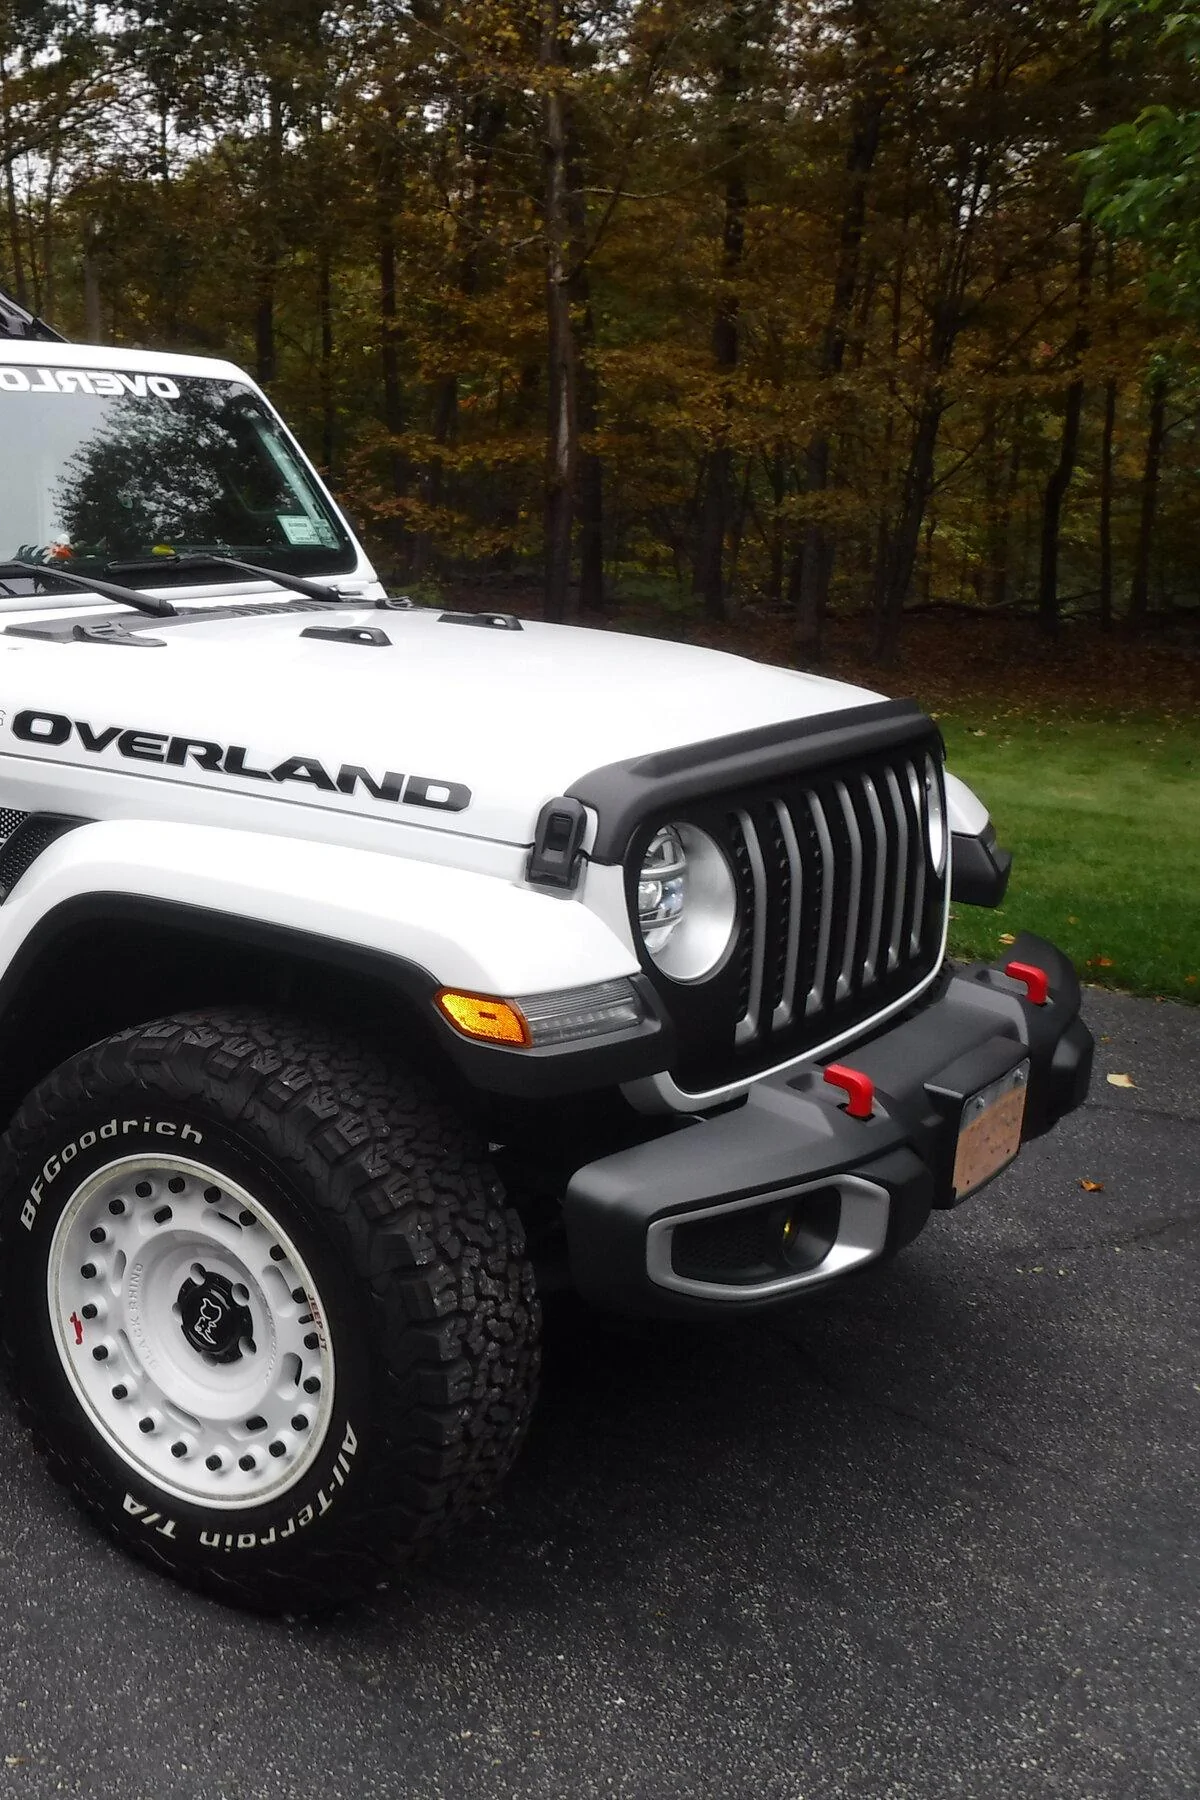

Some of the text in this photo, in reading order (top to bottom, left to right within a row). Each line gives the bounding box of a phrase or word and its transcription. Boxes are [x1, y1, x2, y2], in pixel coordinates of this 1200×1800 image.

[10, 709, 473, 813] OVERLAND
[20, 1116, 204, 1232] BFGoodrich
[307, 1293, 324, 1329] JEEP
[122, 1420, 358, 1552] All-Terrain T/A
